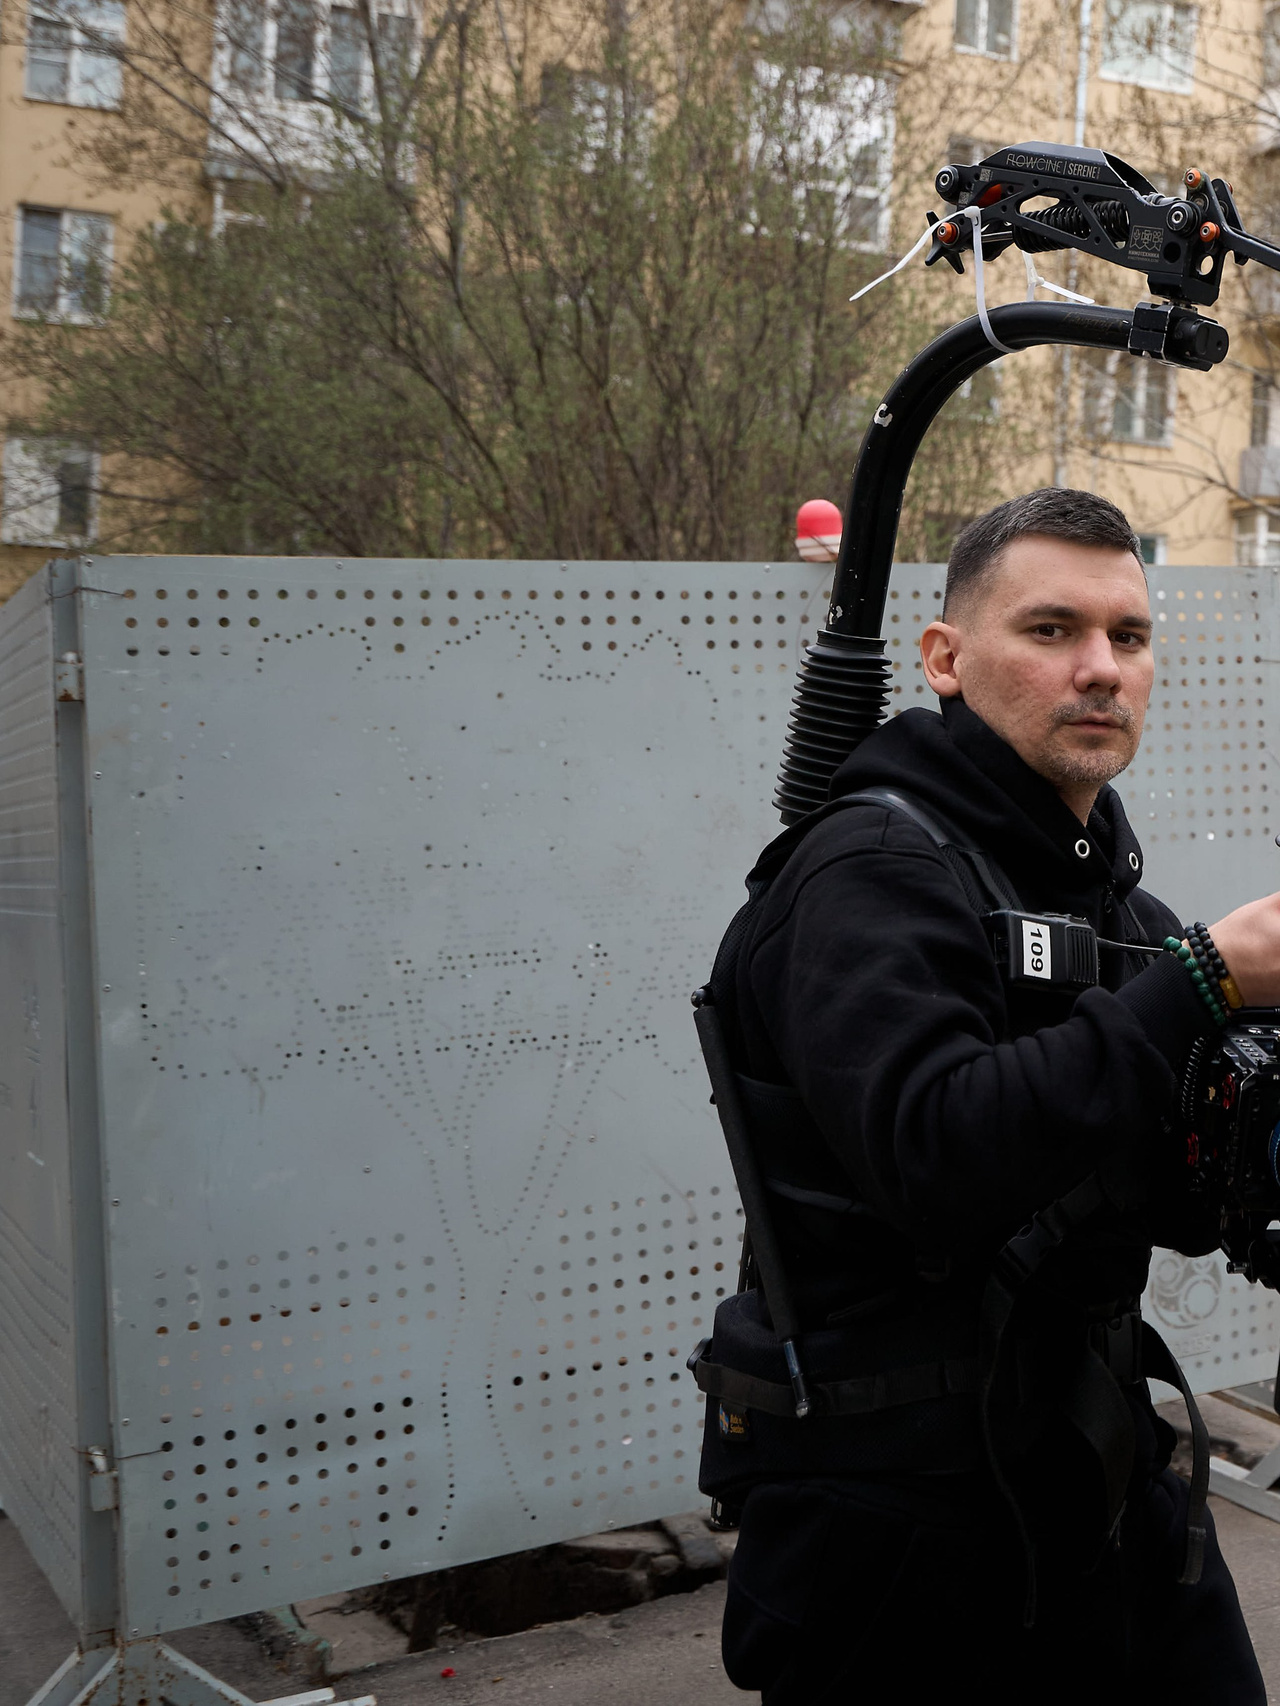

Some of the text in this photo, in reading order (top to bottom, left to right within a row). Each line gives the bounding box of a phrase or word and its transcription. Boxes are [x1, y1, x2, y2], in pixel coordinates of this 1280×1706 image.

[1006, 153, 1063, 174] FLOWCINE
[1068, 162, 1098, 179] SERENE
[1030, 928, 1044, 972] 109
